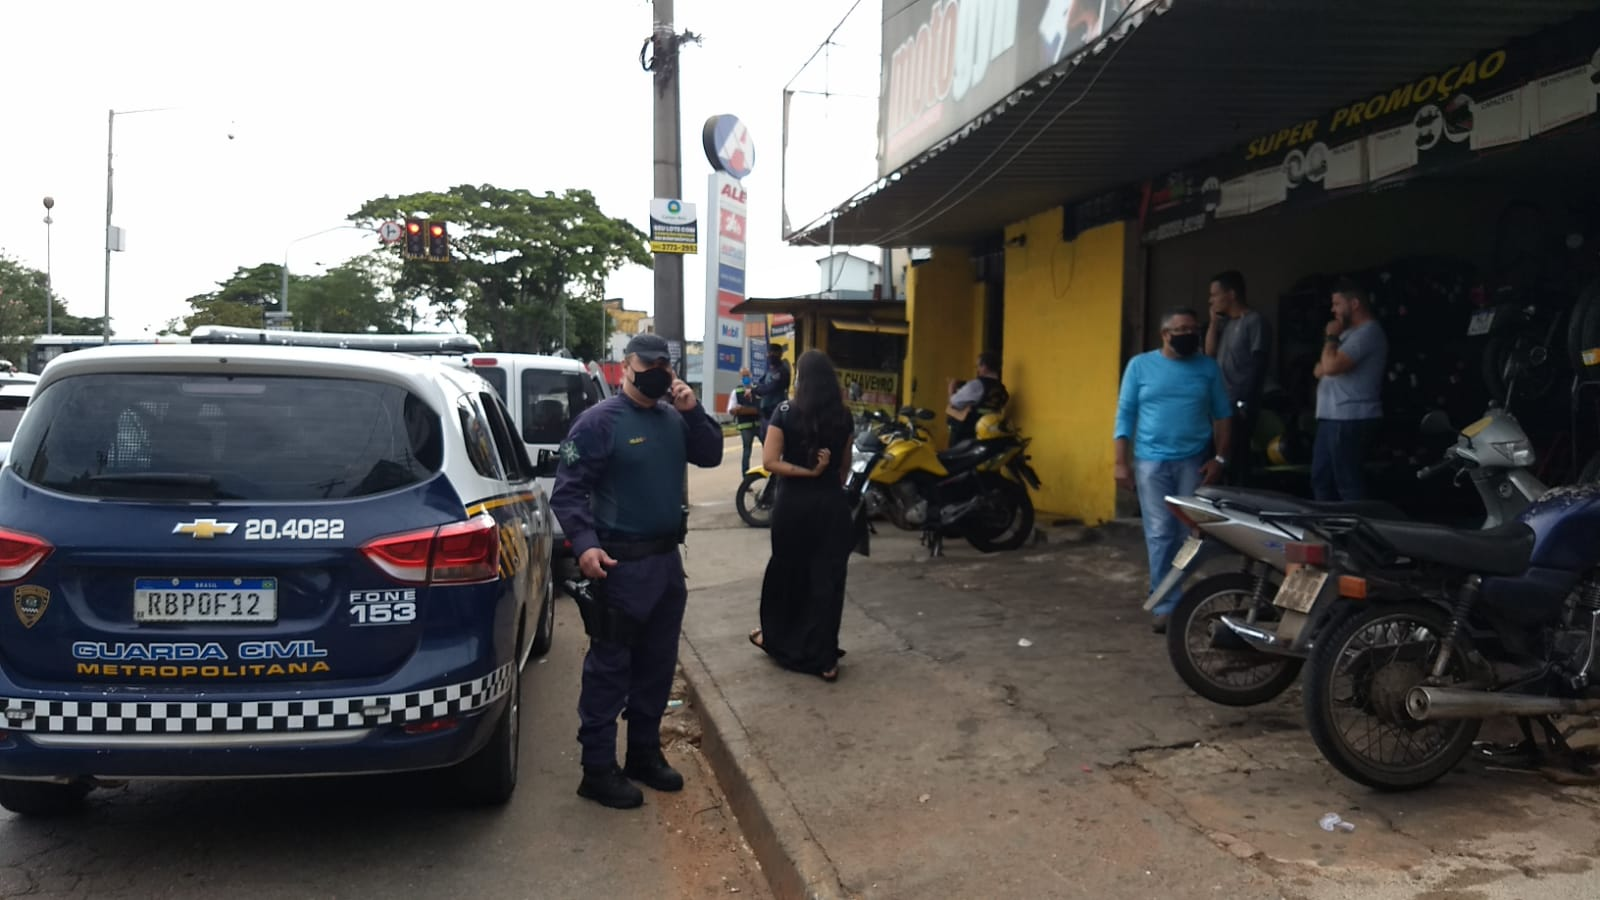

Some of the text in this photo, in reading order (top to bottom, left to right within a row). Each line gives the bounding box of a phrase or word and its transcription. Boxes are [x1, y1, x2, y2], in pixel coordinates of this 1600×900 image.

[1246, 119, 1318, 160] SUPER
[721, 183, 747, 204] ALE
[245, 519, 344, 540] 20.4022
[350, 590, 416, 603] FONE
[350, 603, 416, 623] 153
[72, 640, 328, 660] GUARDA CIVIL
[77, 661, 330, 677] METROPOLITANA
